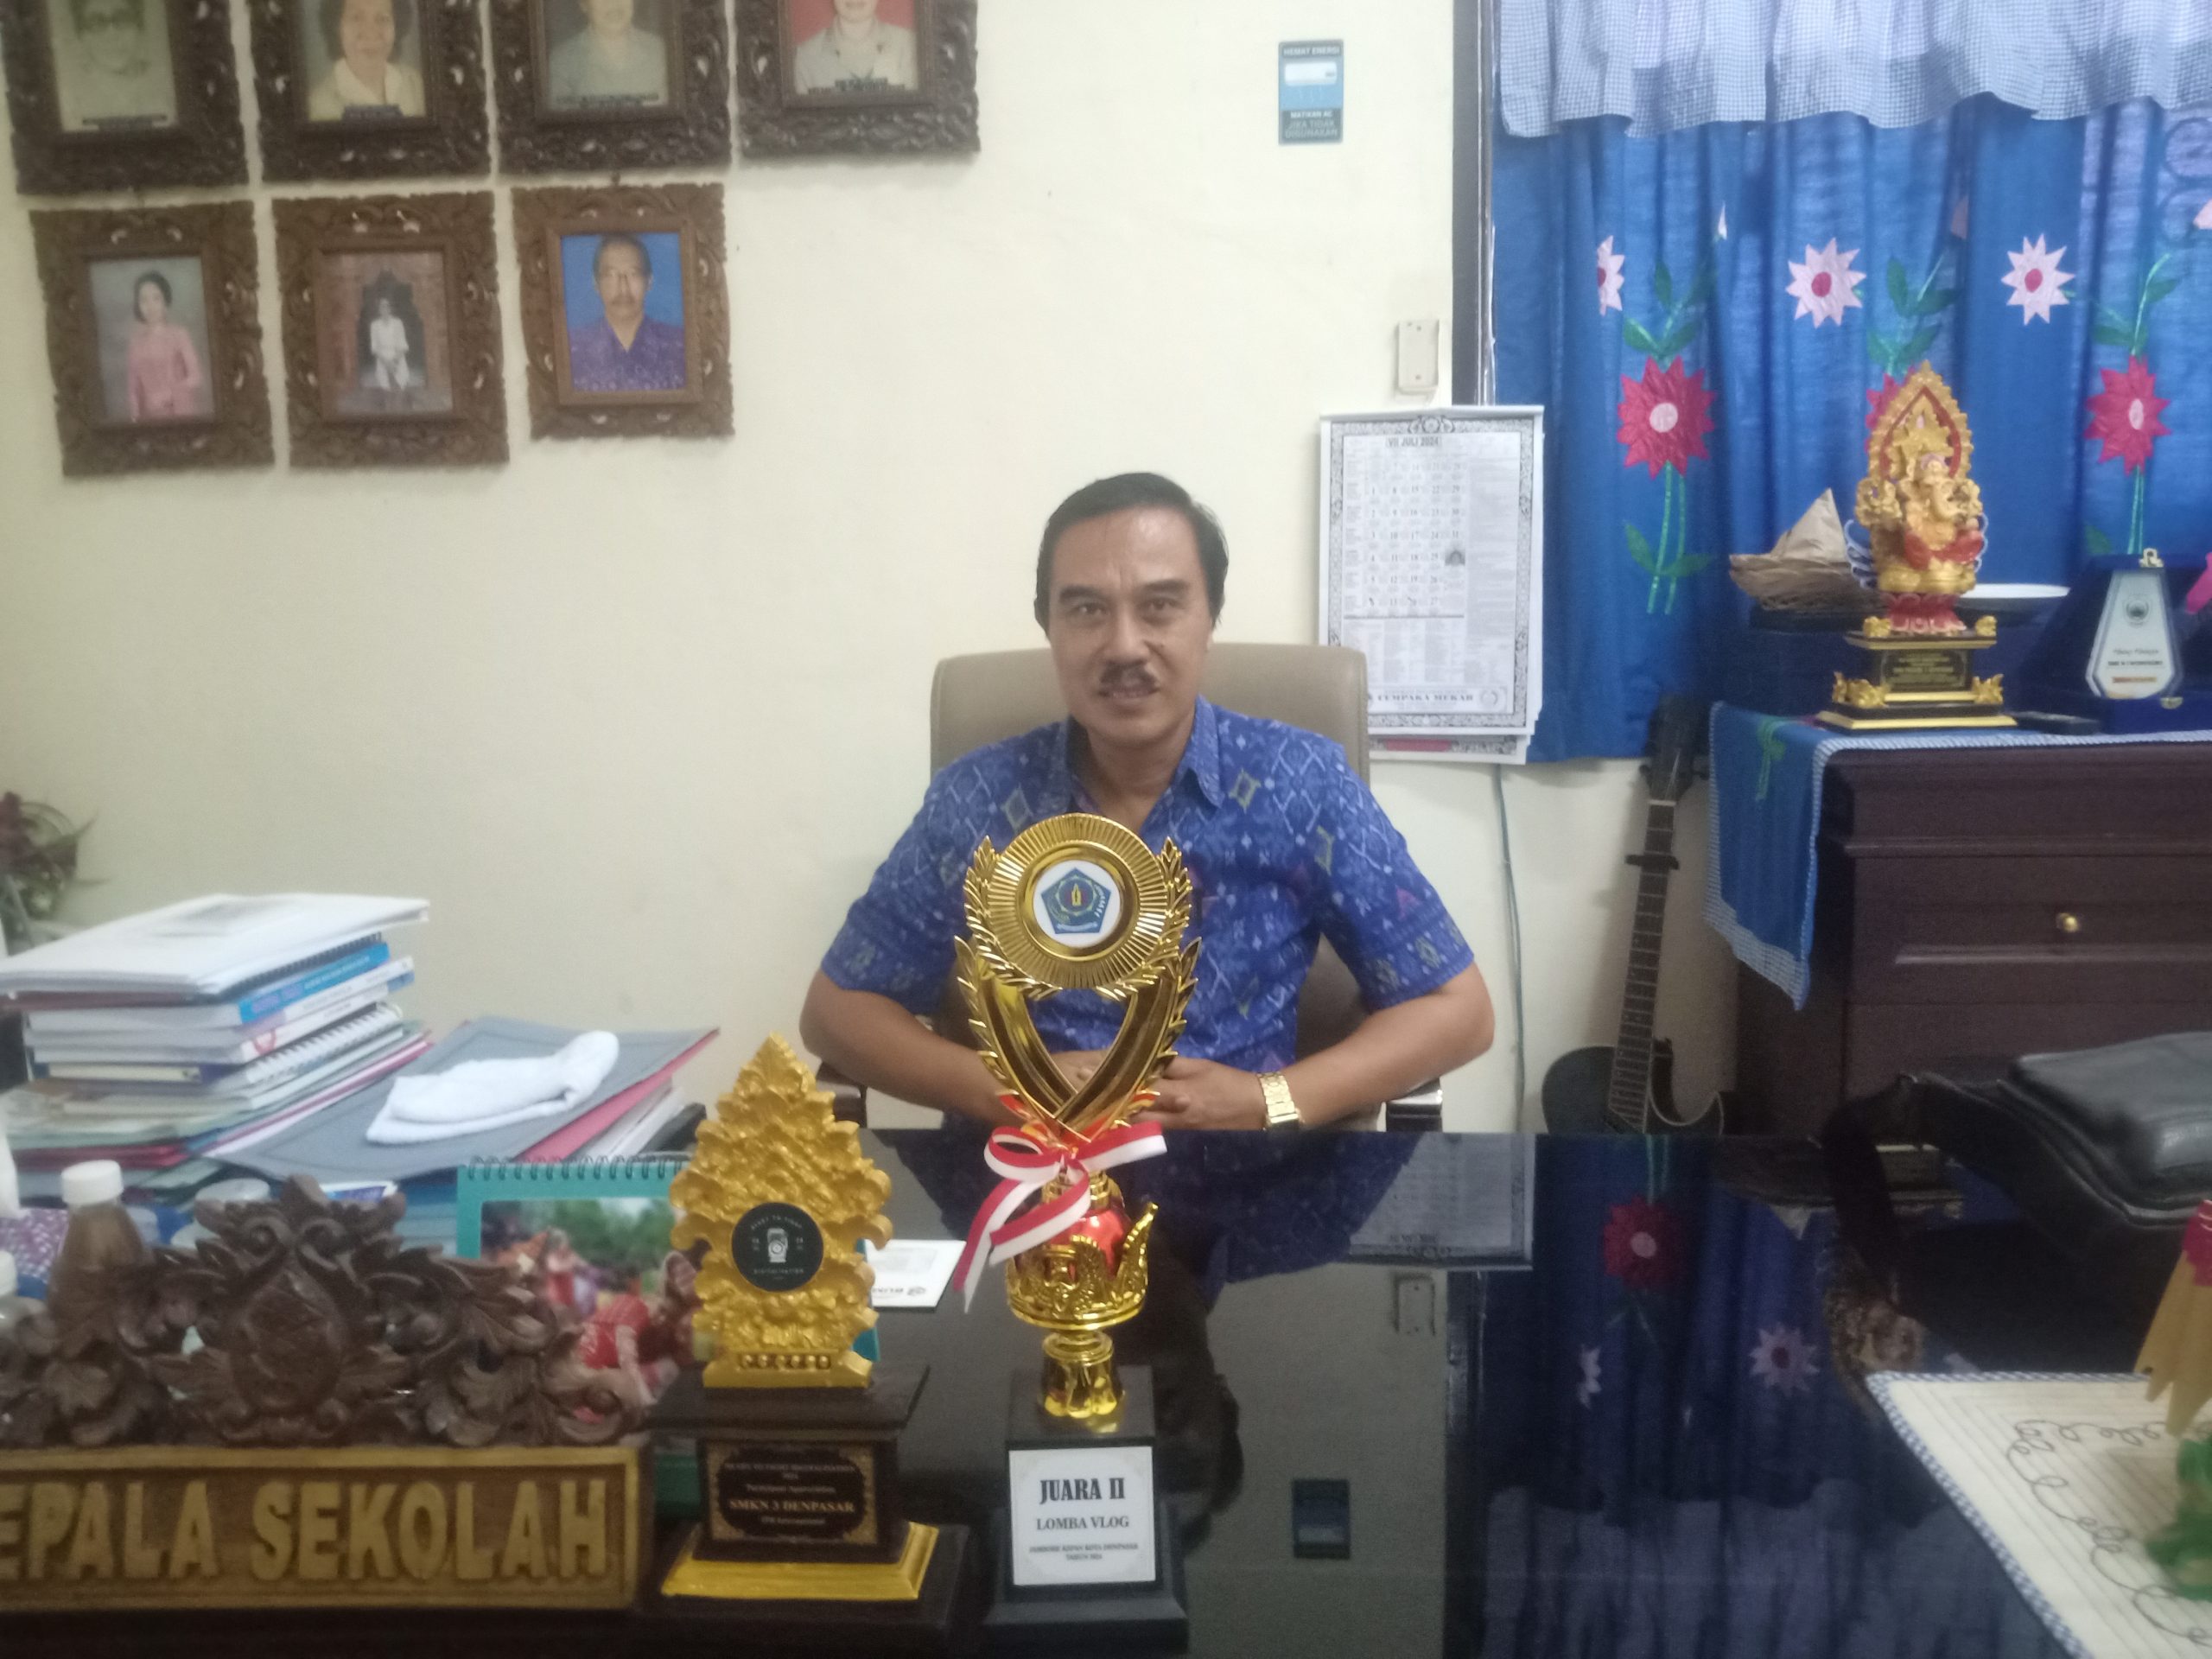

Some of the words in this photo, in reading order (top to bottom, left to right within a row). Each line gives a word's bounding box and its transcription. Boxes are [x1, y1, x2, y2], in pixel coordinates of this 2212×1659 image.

[1402, 437, 1418, 447] JULI
[1420, 436, 1439, 447] 2024
[1039, 1478, 1102, 1504] JUARA
[1109, 1478, 1125, 1499] II
[784, 1500, 855, 1513] DENPASAR
[252, 1480, 607, 1580] SEKOLAH
[1036, 1517, 1088, 1530] LOMBA
[1090, 1516, 1129, 1529] VLOG
